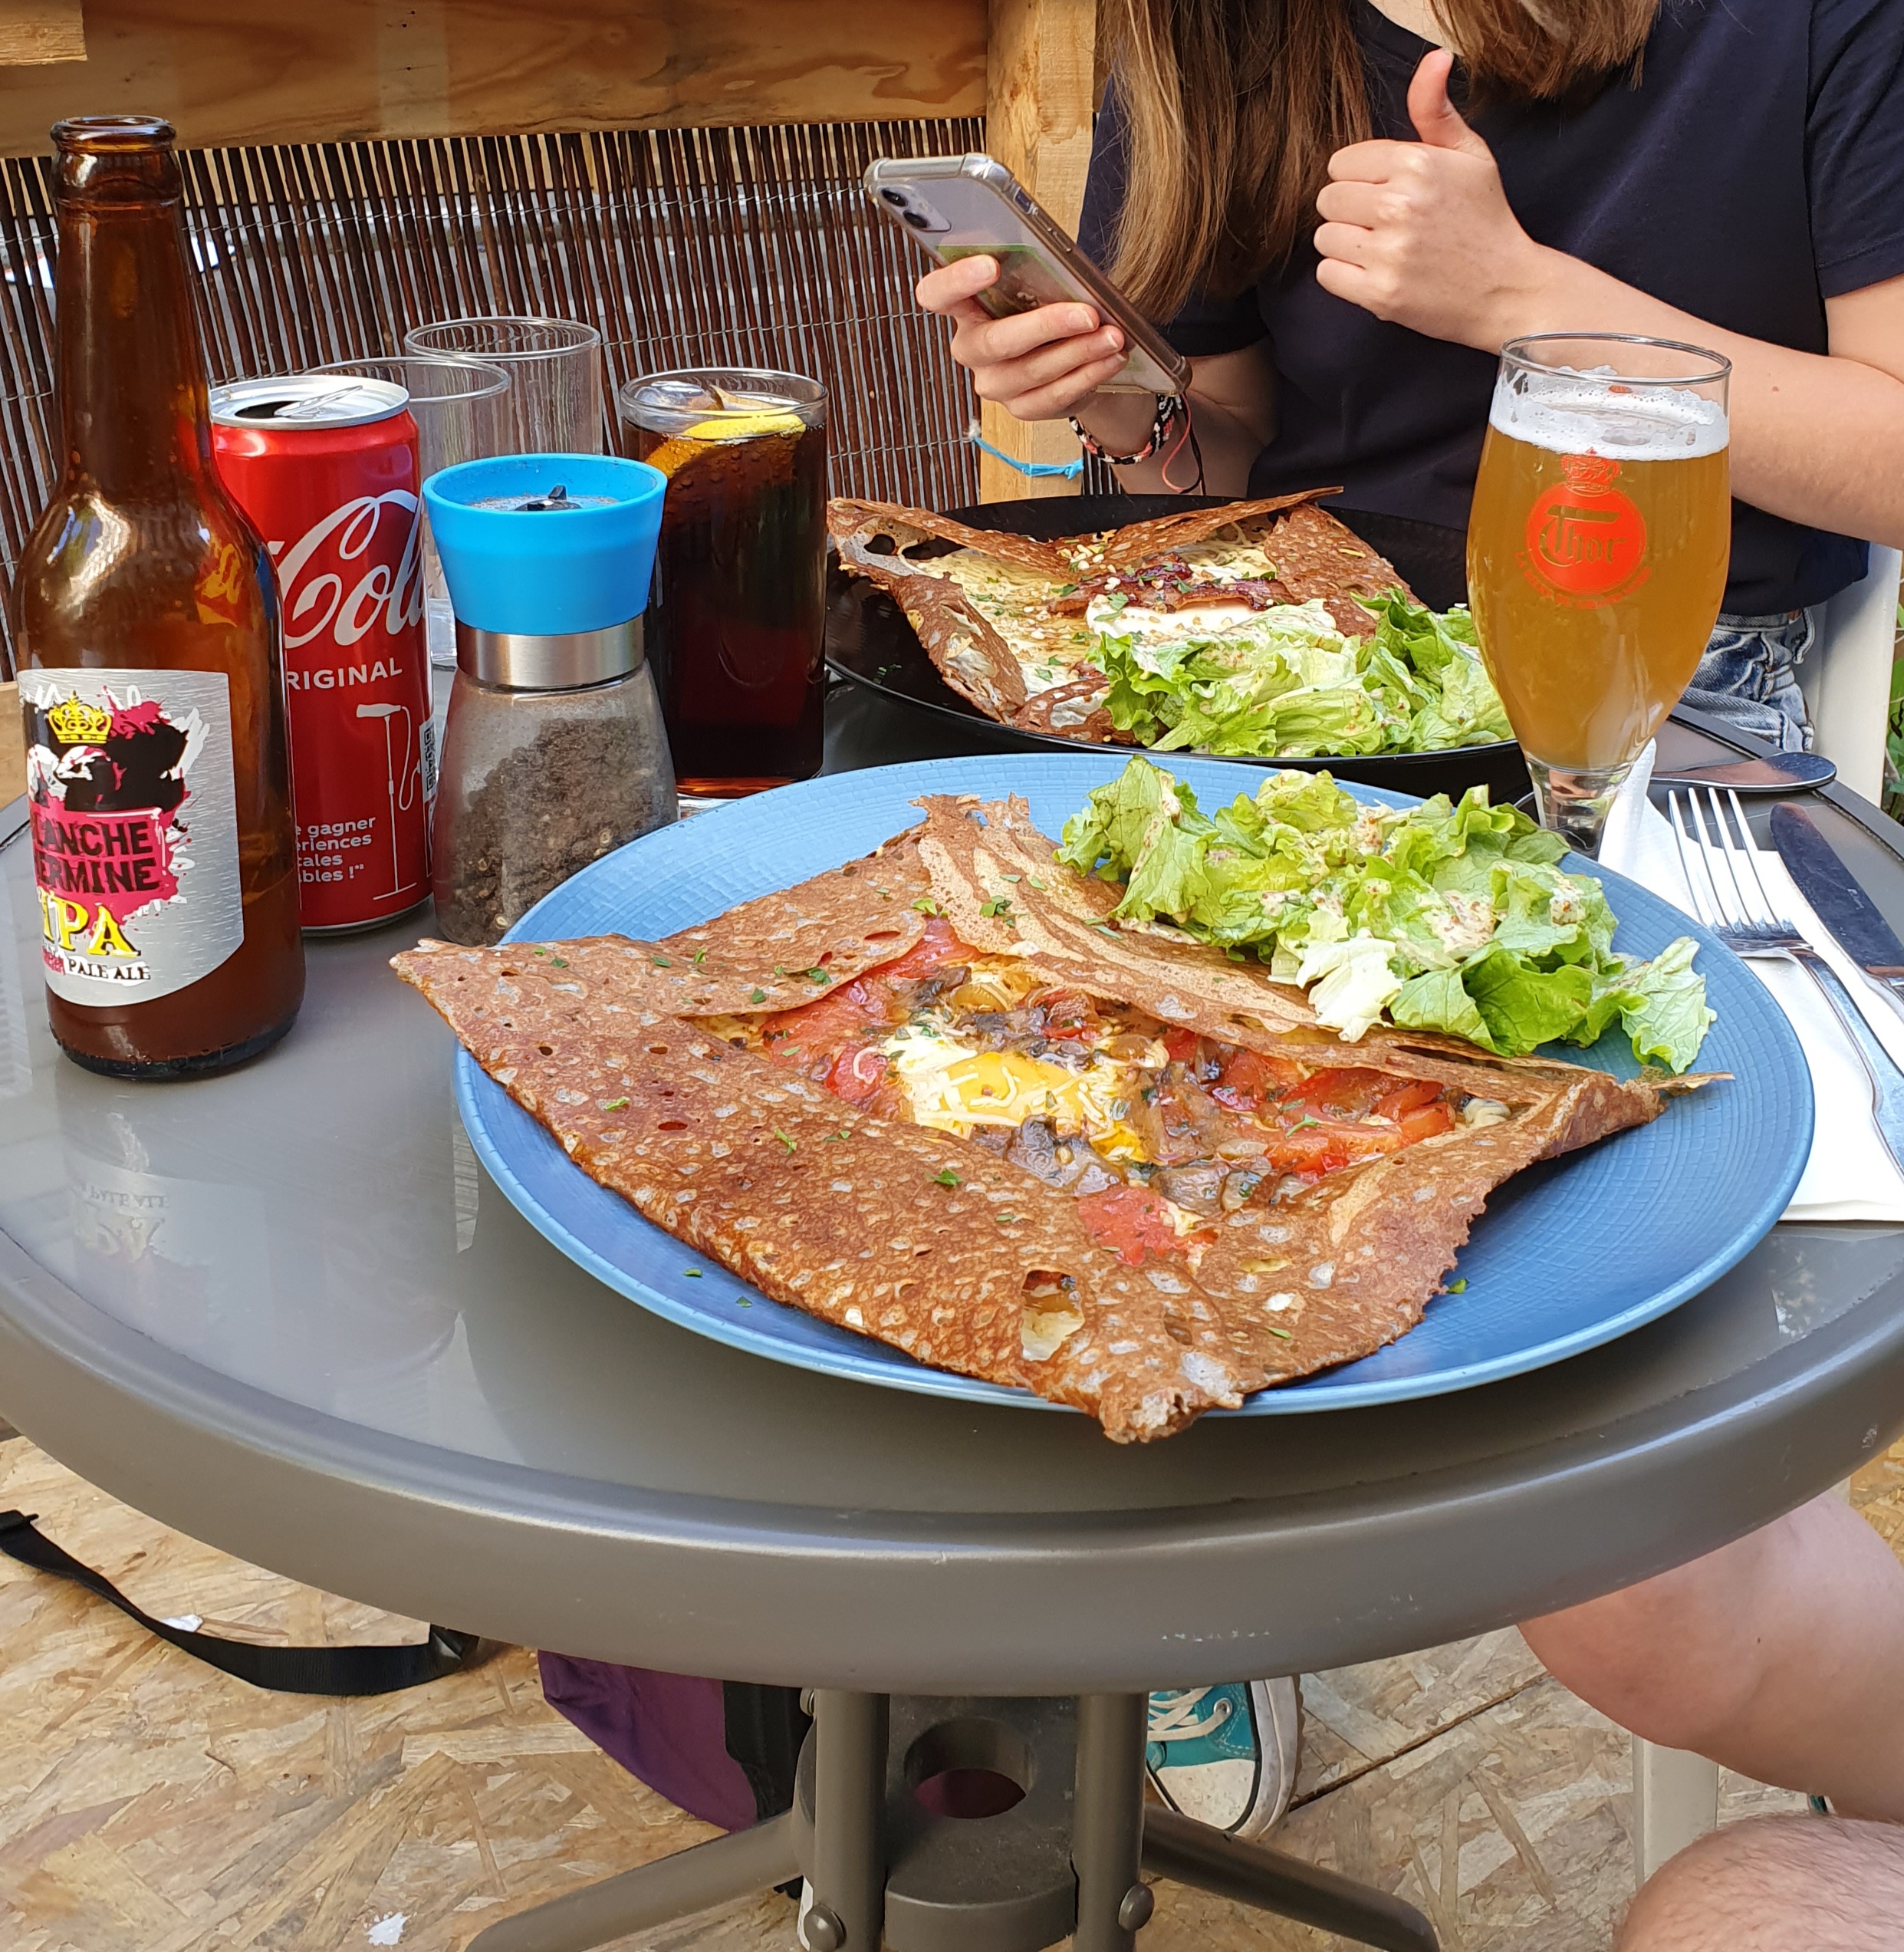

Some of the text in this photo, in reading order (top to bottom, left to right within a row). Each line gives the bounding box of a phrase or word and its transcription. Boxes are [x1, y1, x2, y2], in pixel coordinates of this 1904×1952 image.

[1539, 504, 1627, 567] Thor
[287, 657, 403, 690] RIGINAL
[307, 817, 376, 838] gagner
[298, 834, 372, 851] riences
[299, 854, 343, 867] ales
[37, 851, 160, 894] ERMINE
[300, 870, 344, 883] bles
[69, 958, 109, 979] PALE
[113, 966, 150, 980] ALE
